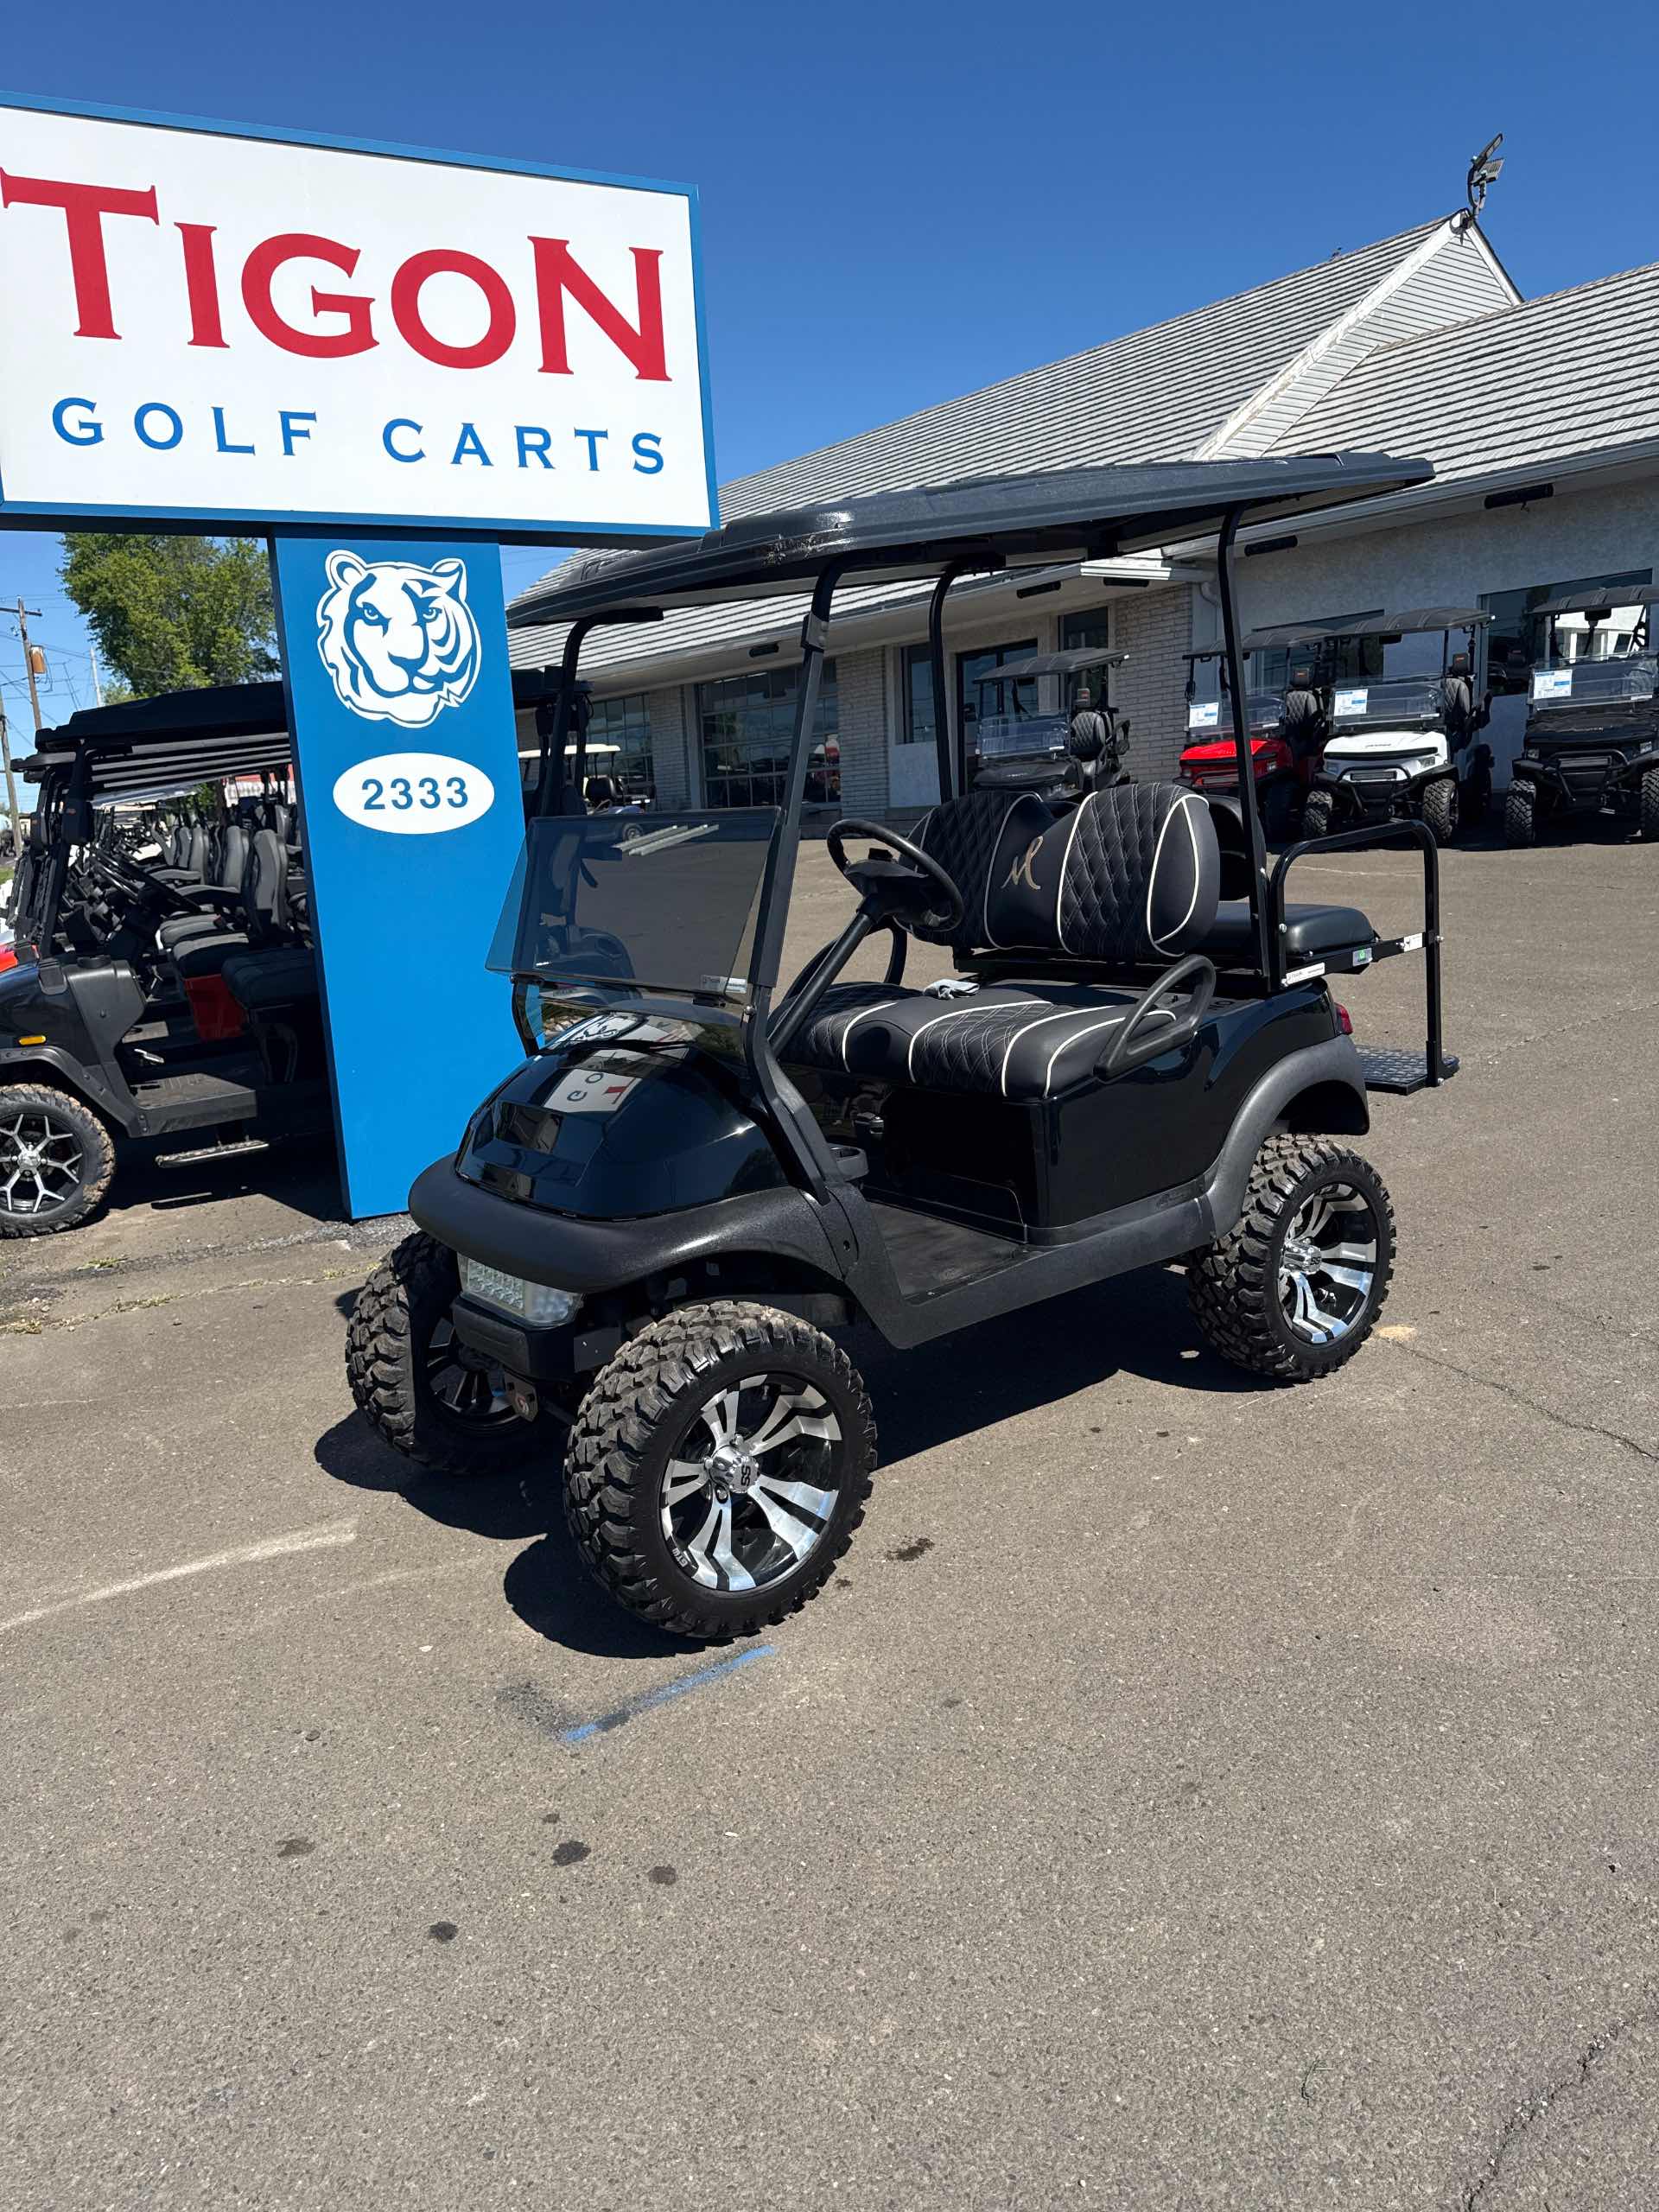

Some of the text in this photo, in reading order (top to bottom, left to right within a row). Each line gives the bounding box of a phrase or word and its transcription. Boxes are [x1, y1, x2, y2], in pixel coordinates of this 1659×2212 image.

[0, 167, 671, 382] TIGON
[52, 397, 664, 475] GOLF CARTS
[361, 776, 469, 810] 2333
